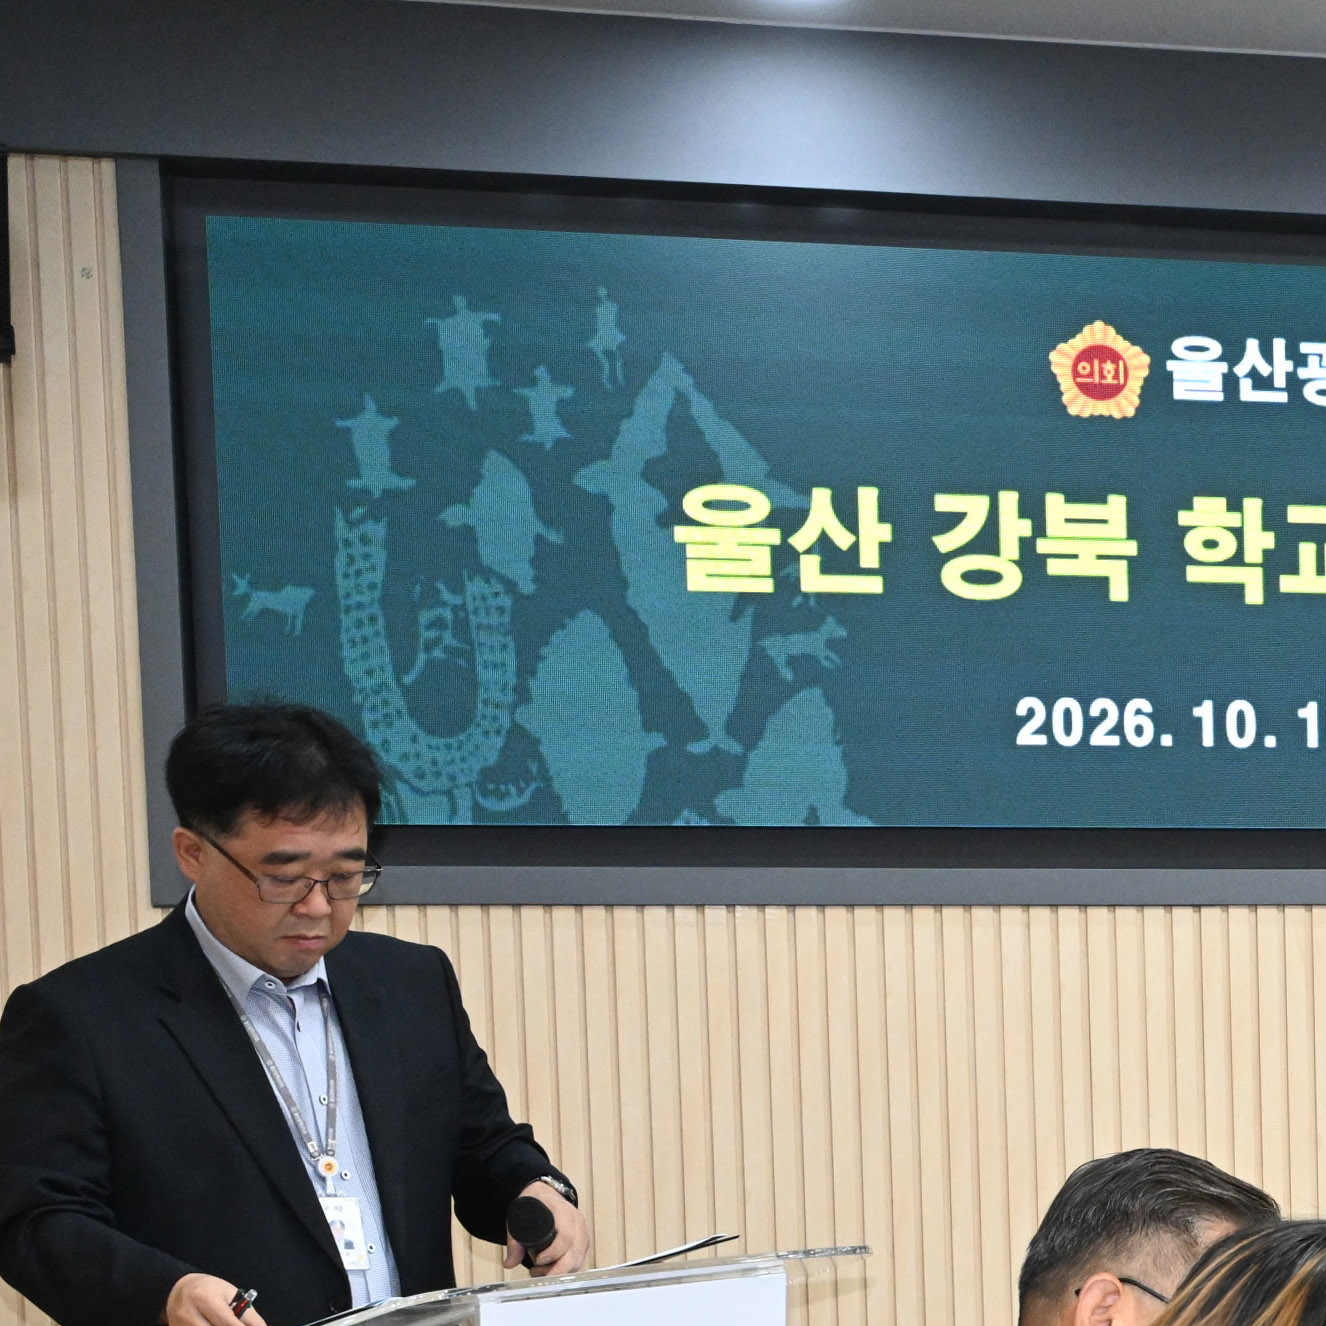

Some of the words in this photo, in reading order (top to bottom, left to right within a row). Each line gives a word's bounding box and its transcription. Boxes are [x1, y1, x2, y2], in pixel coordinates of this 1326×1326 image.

[1076, 358, 1124, 385] 의회
[673, 484, 892, 594] 울산
[932, 490, 1138, 602] 강북
[1015, 696, 1173, 748] 2026.
[1192, 699, 1277, 749] 10.
